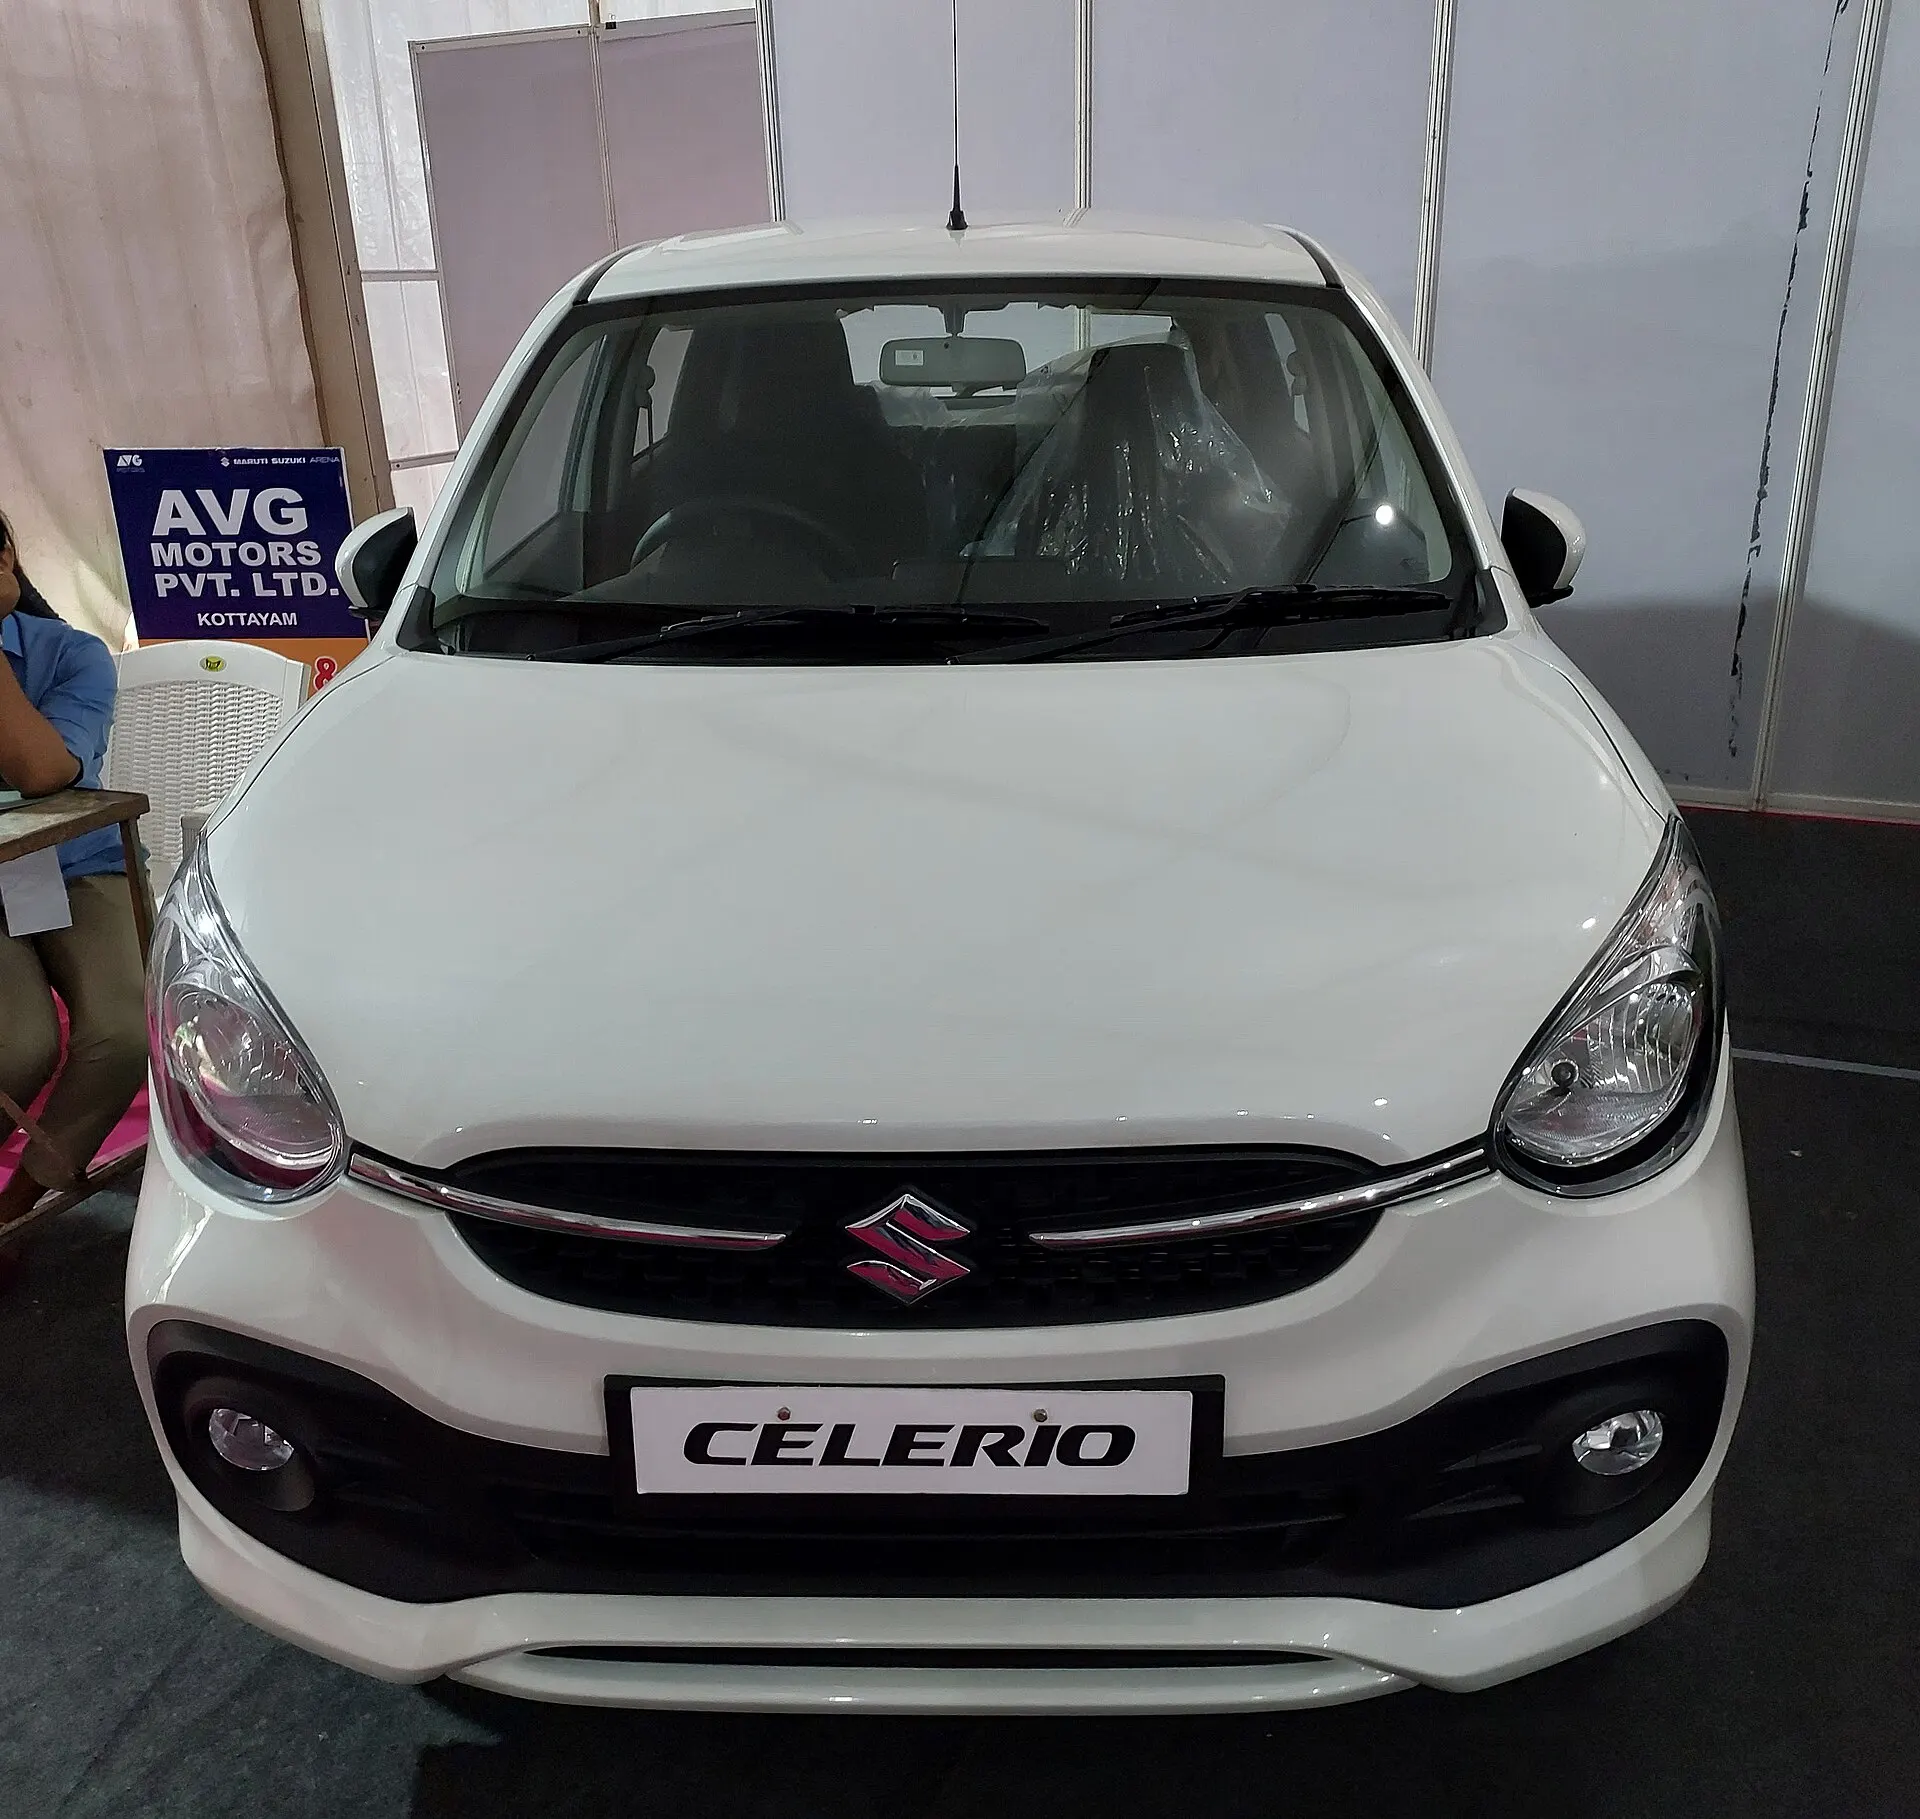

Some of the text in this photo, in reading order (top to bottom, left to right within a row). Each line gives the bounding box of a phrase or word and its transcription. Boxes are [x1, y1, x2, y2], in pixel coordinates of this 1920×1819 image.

[152, 487, 308, 536] AVG
[151, 541, 321, 566] MOTORS
[155, 572, 339, 597] PVT. LTD.
[197, 613, 297, 625] KOTTAYAM
[682, 1422, 1136, 1467] CELERIO
